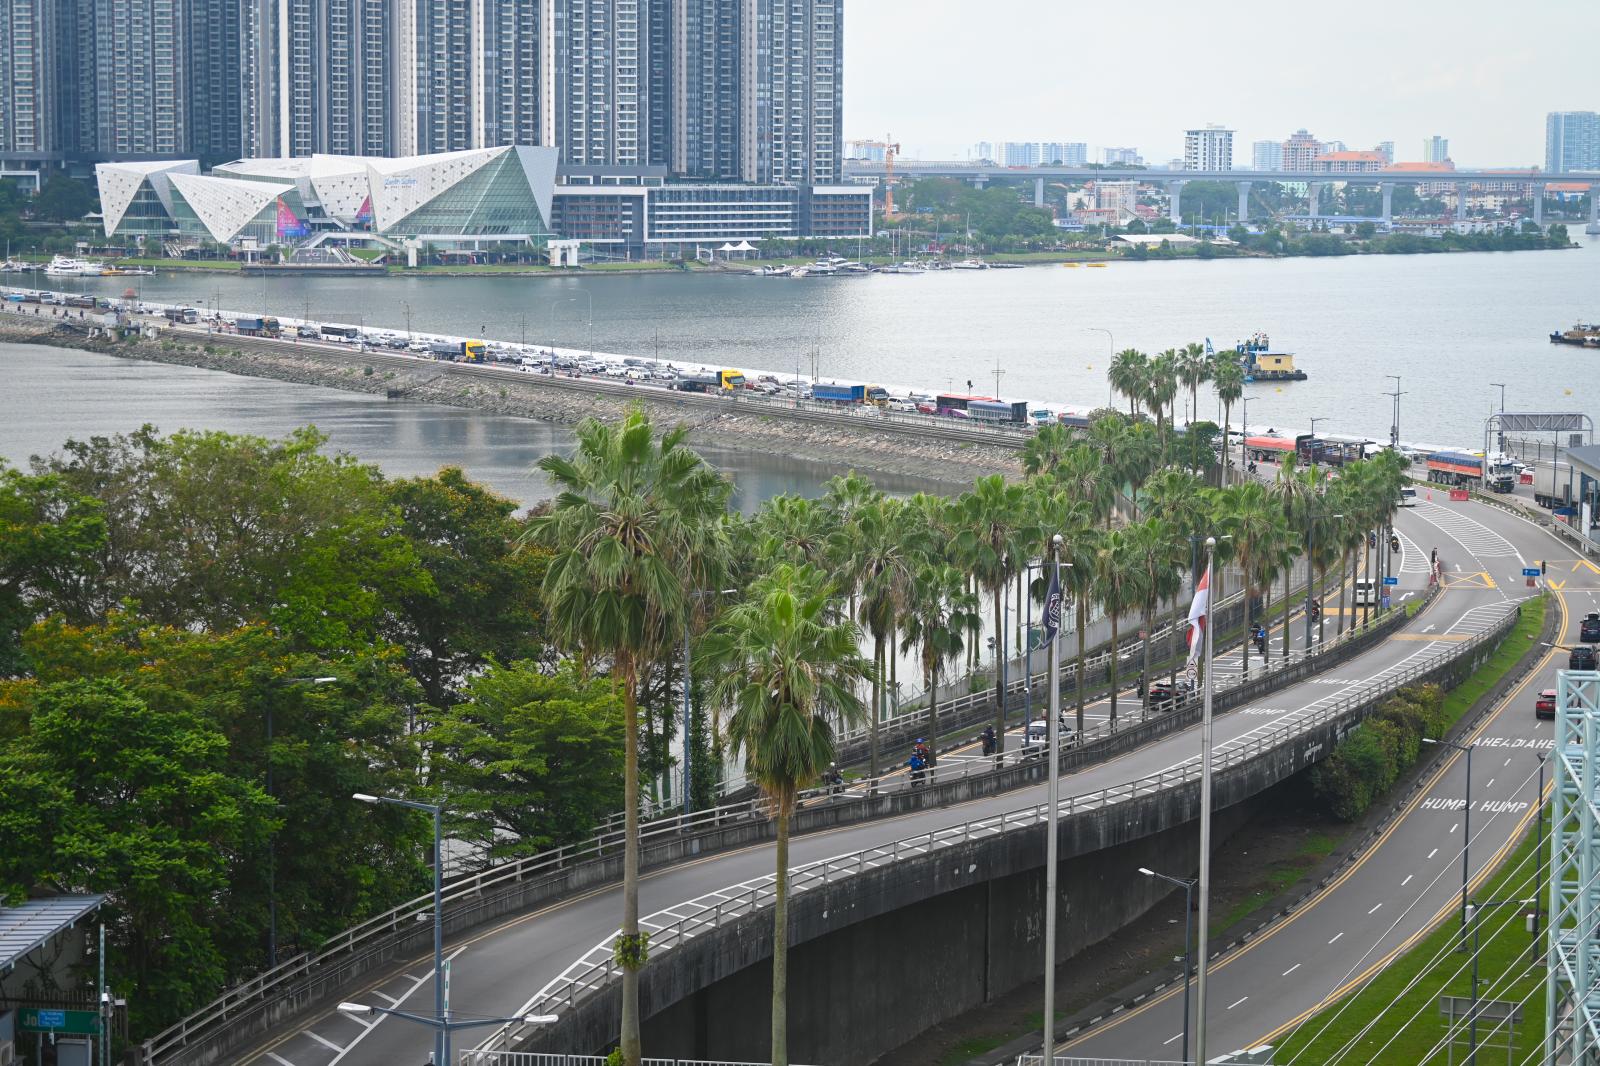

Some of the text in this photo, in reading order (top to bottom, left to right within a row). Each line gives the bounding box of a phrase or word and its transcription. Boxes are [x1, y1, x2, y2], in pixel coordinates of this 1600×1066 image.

[1471, 737, 1522, 748] AHEAD
[1420, 797, 1468, 810] HUMP
[1480, 800, 1528, 813] HUMP
[24, 1013, 37, 1026] Jo
